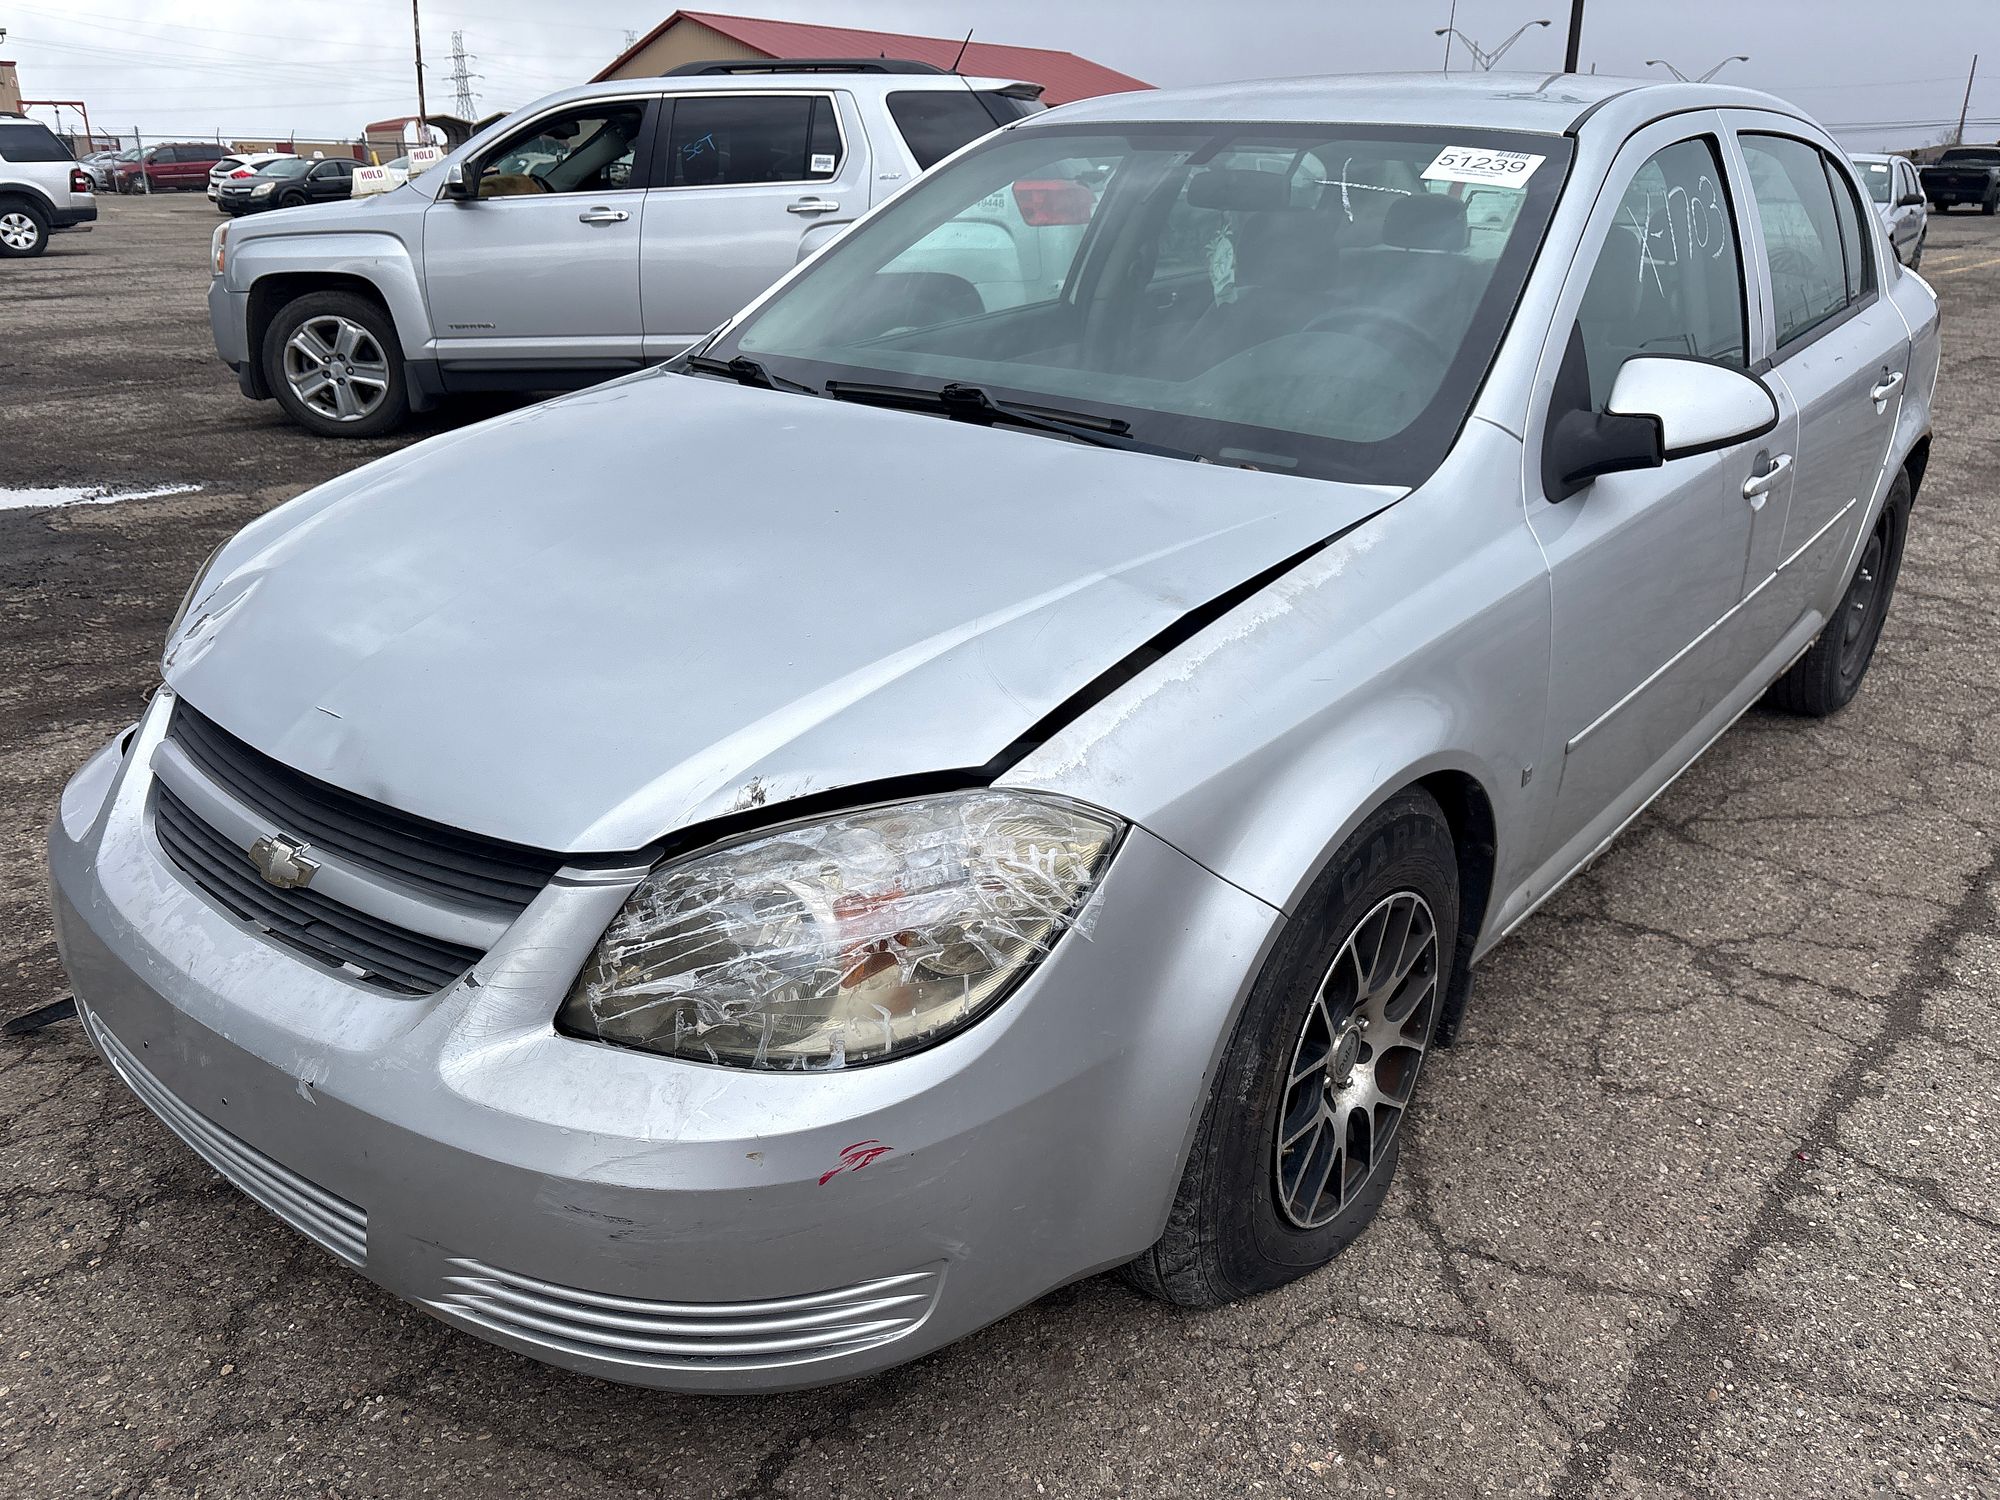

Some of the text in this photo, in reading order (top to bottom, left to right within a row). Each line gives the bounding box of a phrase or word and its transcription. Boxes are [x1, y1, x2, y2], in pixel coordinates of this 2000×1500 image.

[413, 149, 434, 161] HOLD
[1438, 154, 1526, 173] 51239
[360, 169, 383, 180] HOLD
